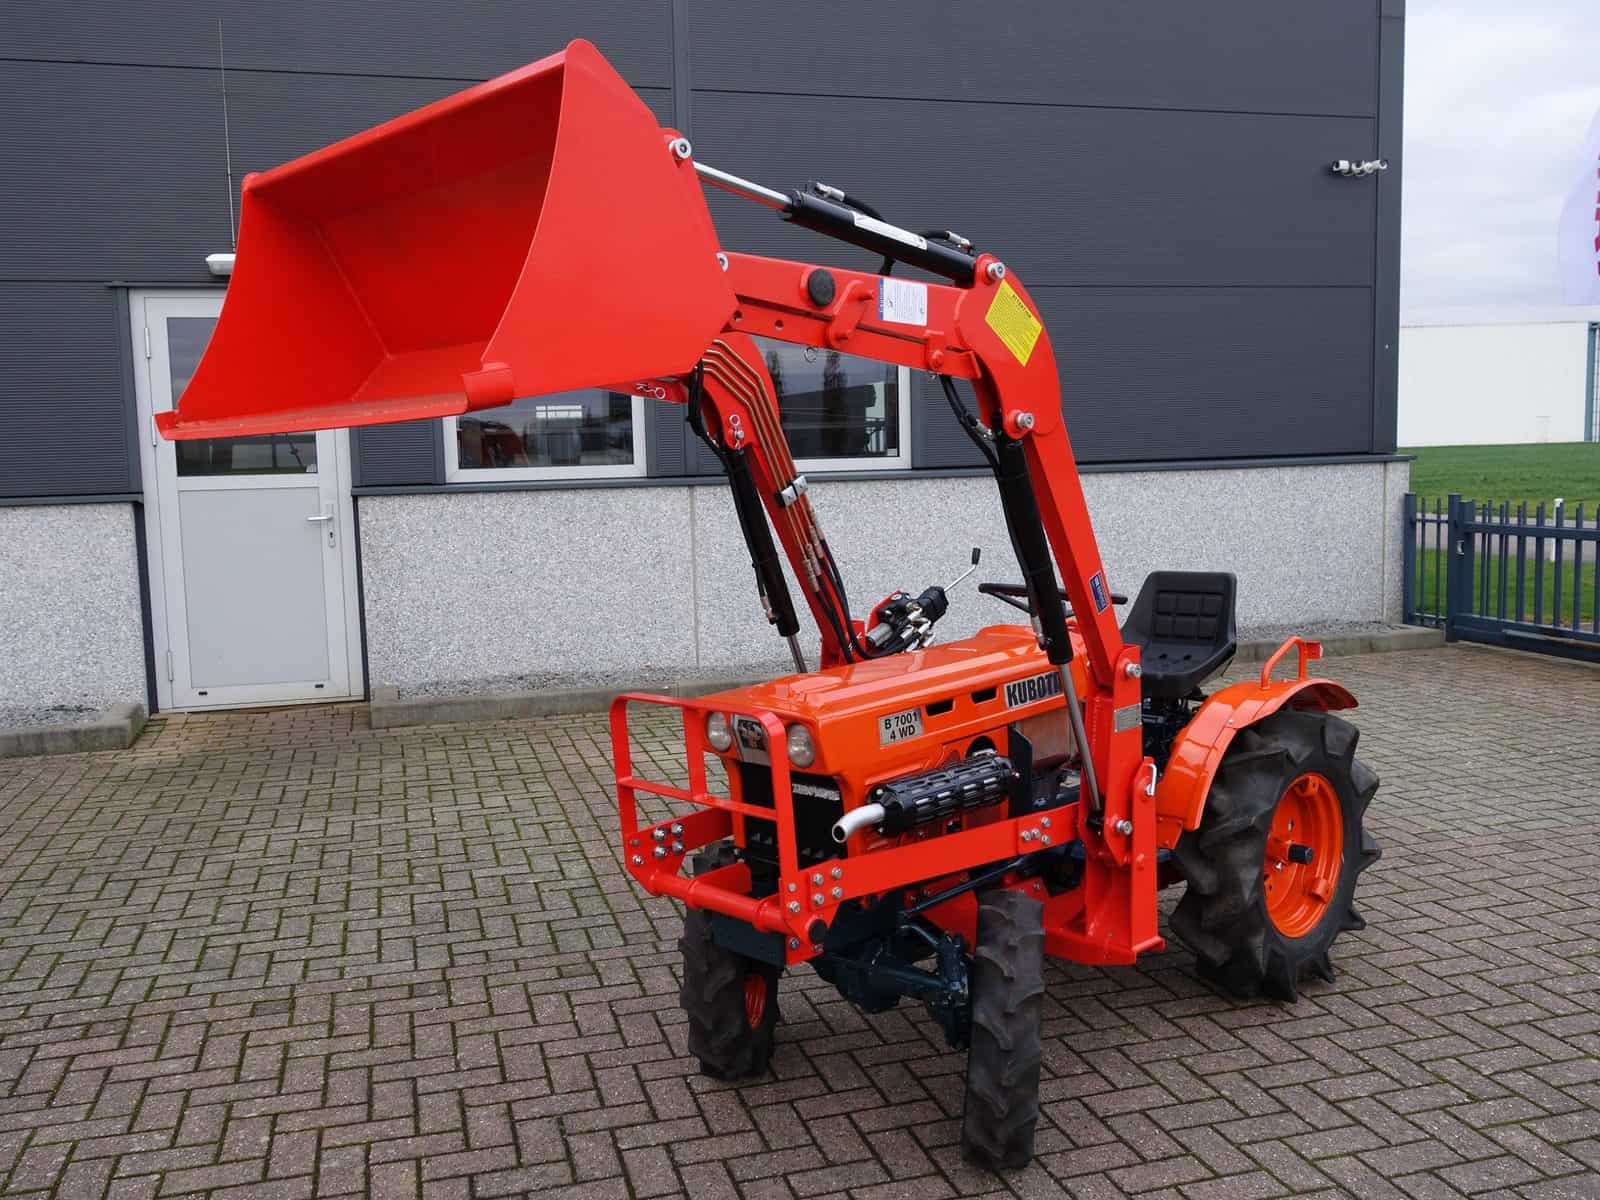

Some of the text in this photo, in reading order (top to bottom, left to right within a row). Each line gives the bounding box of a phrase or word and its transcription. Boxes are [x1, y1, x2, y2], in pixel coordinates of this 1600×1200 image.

[884, 711, 918, 730] B 7001
[890, 724, 916, 741] 4 WD
